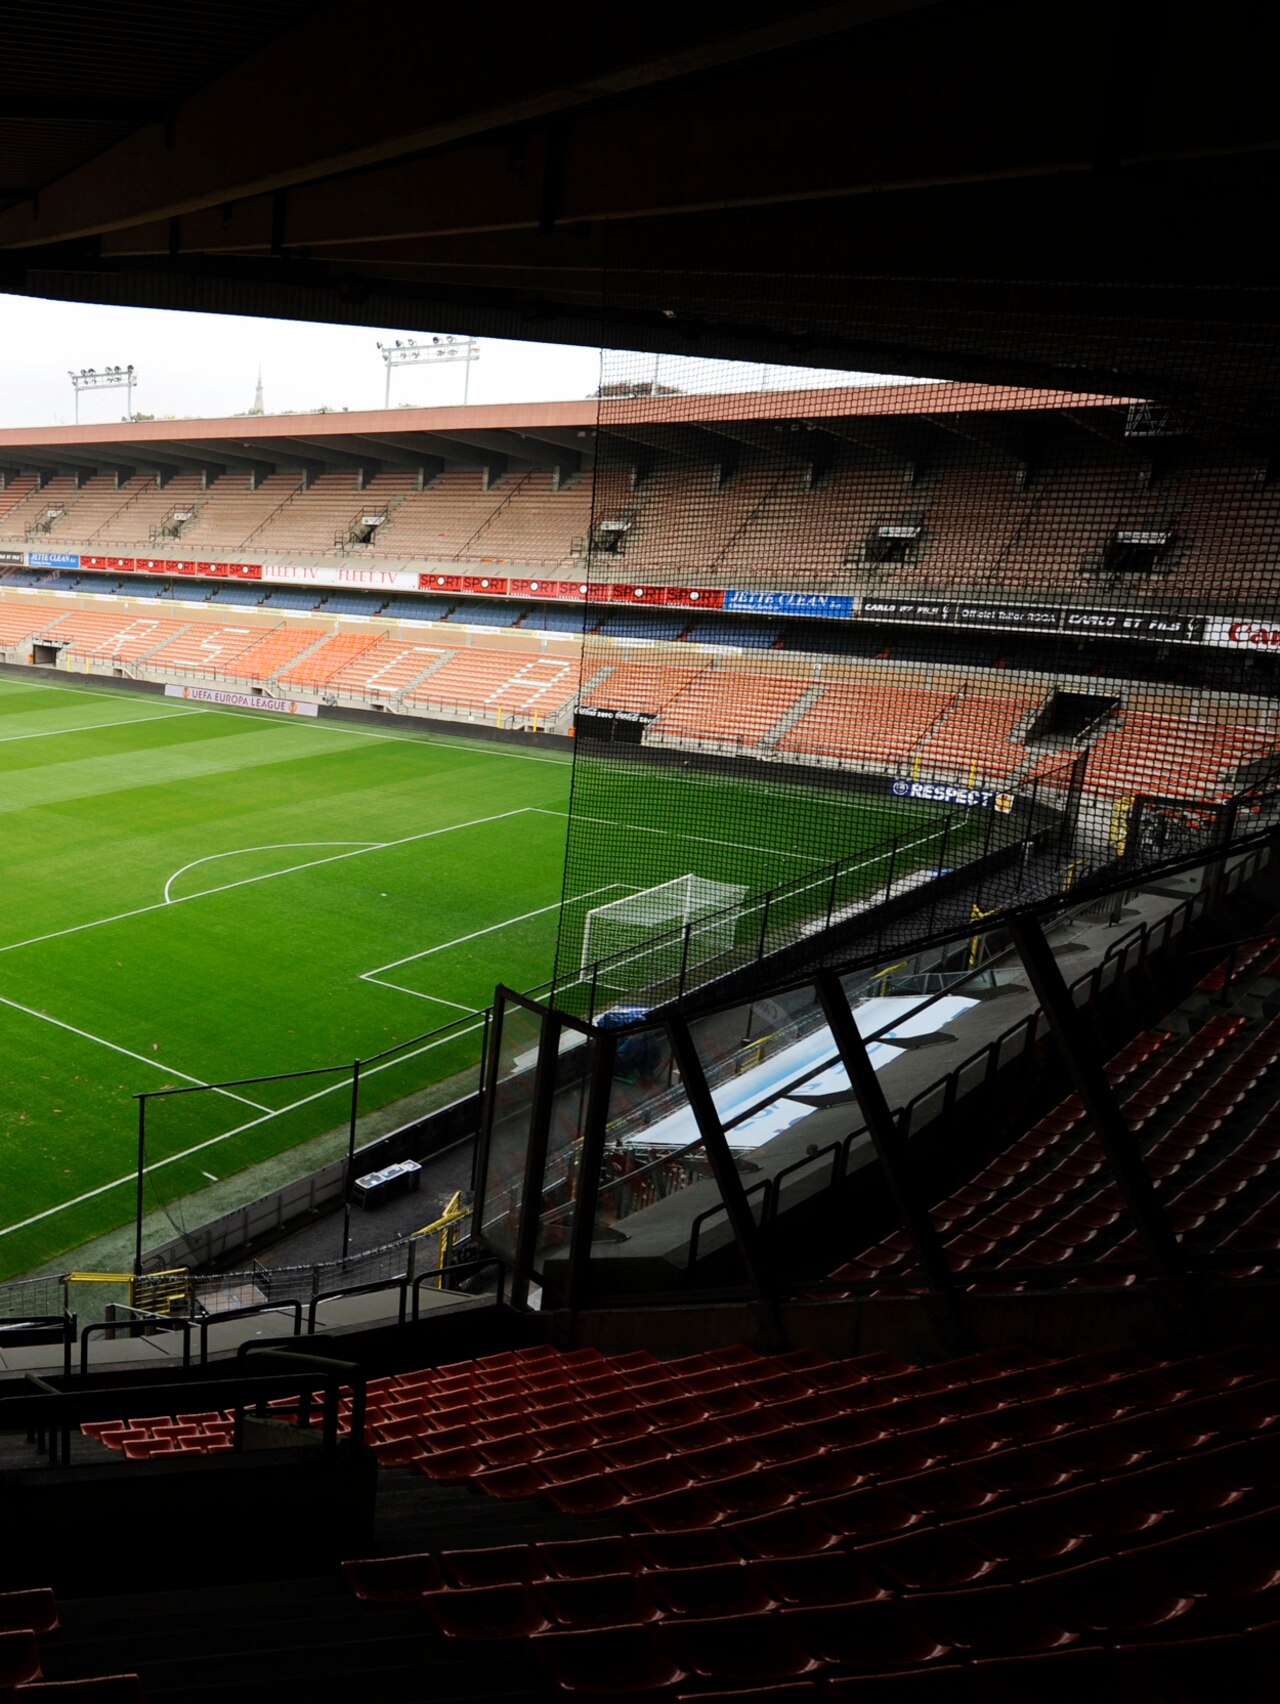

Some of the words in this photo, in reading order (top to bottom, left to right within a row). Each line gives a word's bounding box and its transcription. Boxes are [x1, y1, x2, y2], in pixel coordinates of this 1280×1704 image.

[82, 557, 106, 568] SPORT
[107, 558, 134, 570] SPORT
[137, 559, 165, 571] SPORT
[166, 561, 195, 573] SPORT
[198, 562, 228, 575] SPORT
[230, 564, 262, 577] SPORT
[421, 574, 462, 587] SPORT
[464, 576, 507, 591] SPORT
[512, 579, 558, 593] SPORT
[559, 581, 609, 598] SPORT
[614, 584, 665, 600] SPORT
[668, 587, 723, 605] SPORT
[779, 593, 829, 607] CLEAN
[864, 603, 895, 612] CARLO
[1068, 614, 1117, 626] CARLO
[1123, 617, 1145, 628] ET
[192, 689, 213, 701] UEFA
[214, 692, 249, 706] EUROPA
[251, 698, 286, 711] LEAGUE
[910, 783, 993, 807] RESPECT
